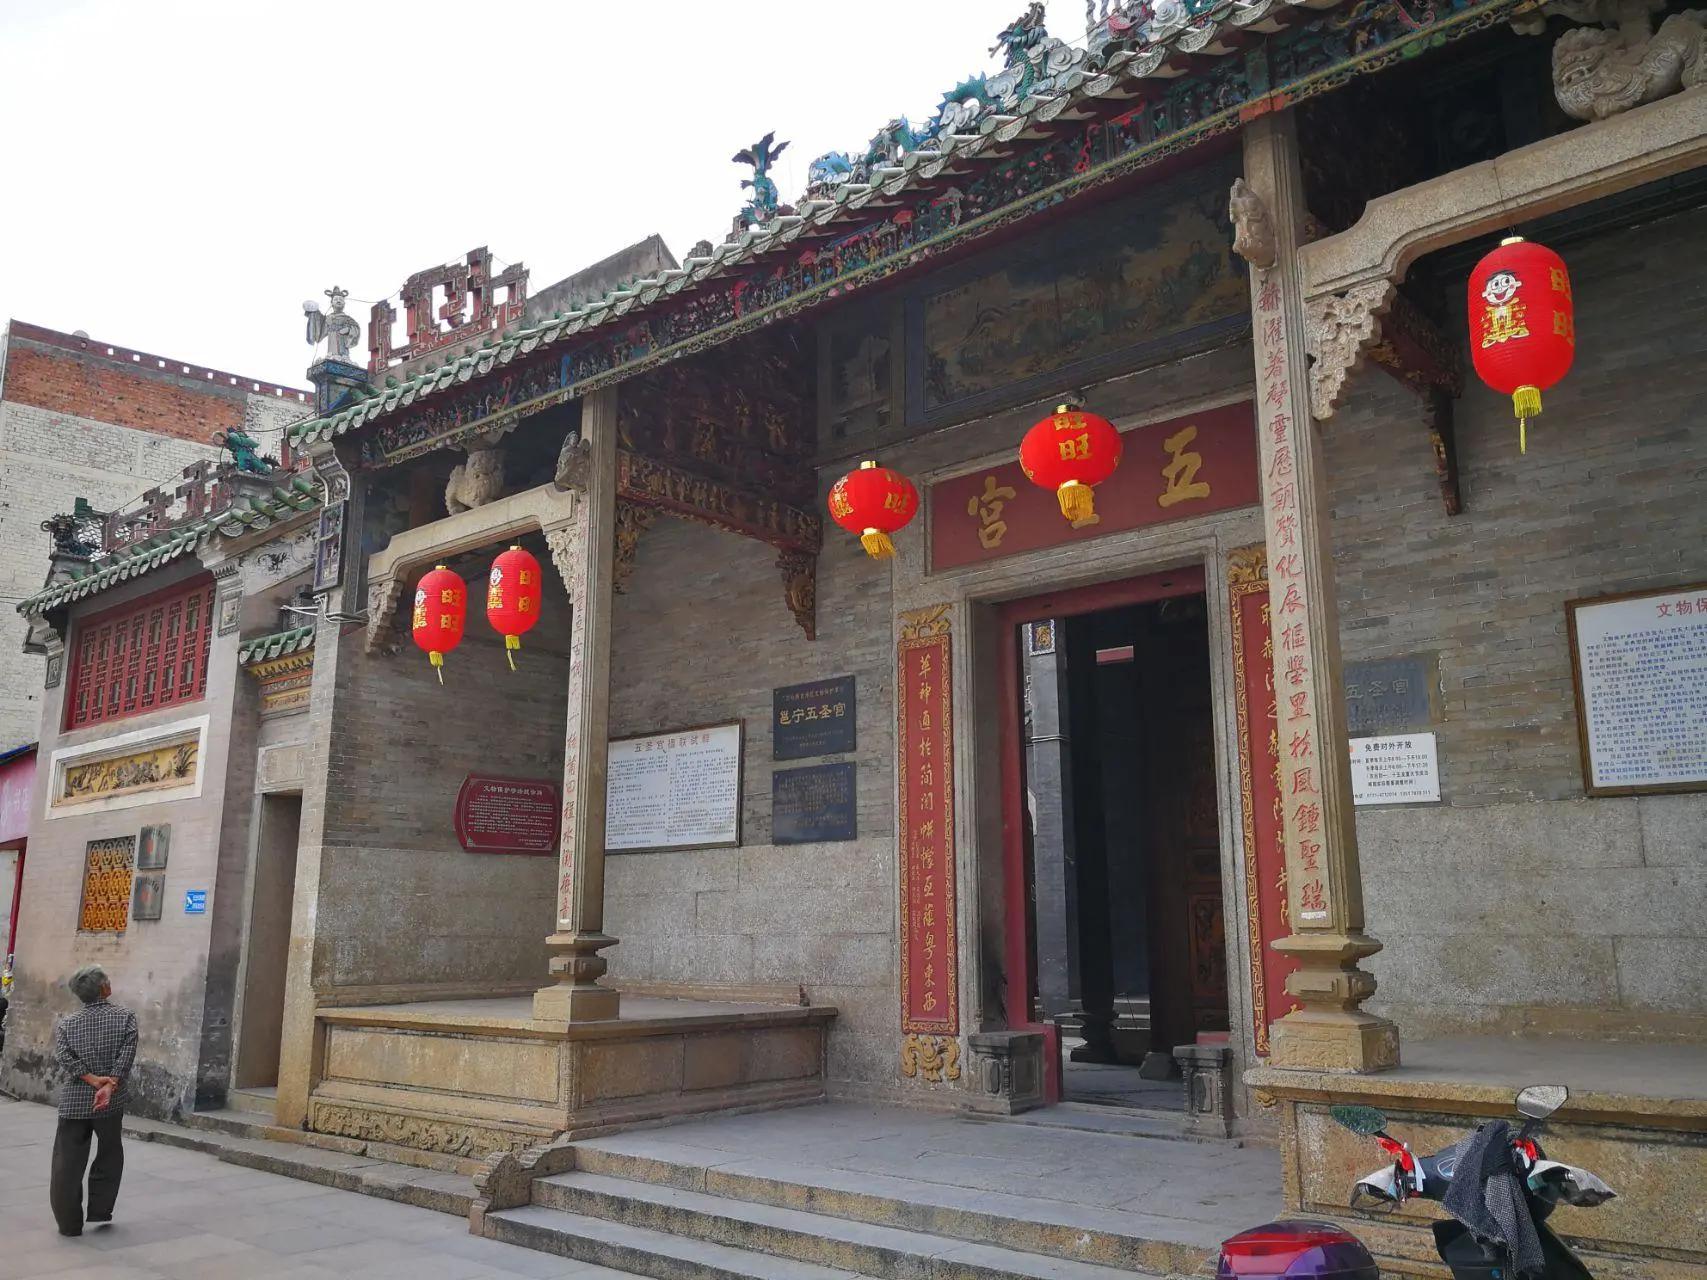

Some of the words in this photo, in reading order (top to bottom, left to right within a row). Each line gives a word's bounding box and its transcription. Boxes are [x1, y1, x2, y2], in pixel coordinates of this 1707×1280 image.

[1053, 415, 1092, 461] 旺旺
[968, 425, 1211, 549] 五宫
[440, 588, 462, 632] 旺旺
[1345, 678, 1409, 700] 五圣宫
[779, 702, 846, 725] 邕宁五圣宫
[1365, 740, 1412, 752] 免费对外开放
